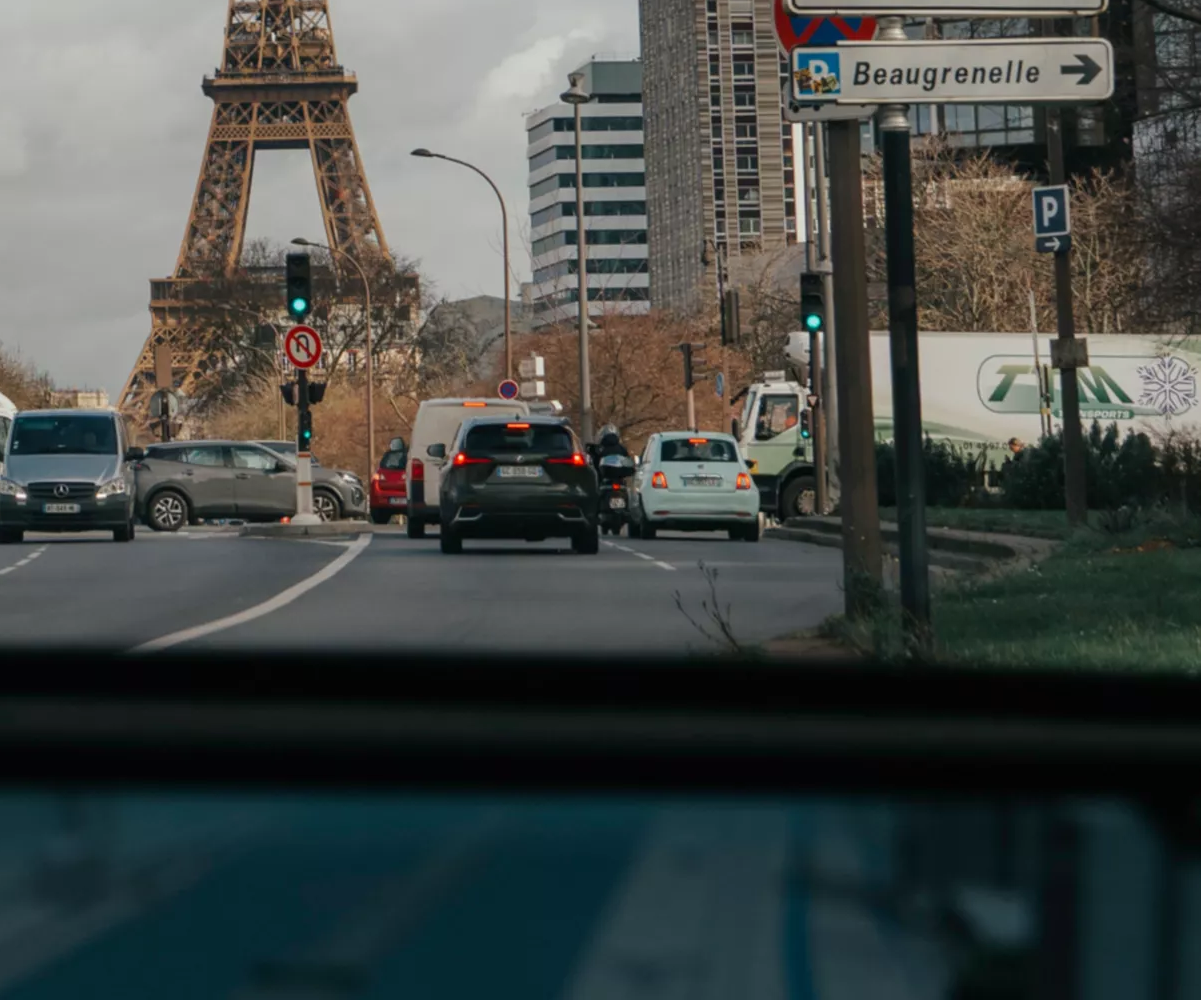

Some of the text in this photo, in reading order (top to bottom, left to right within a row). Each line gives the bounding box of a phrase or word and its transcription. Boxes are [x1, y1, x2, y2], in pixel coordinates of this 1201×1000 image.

[853, 60, 1040, 92] Beaugrenelle
[1042, 196, 1058, 227] P
[1059, 409, 1130, 420] TNSPORTS
